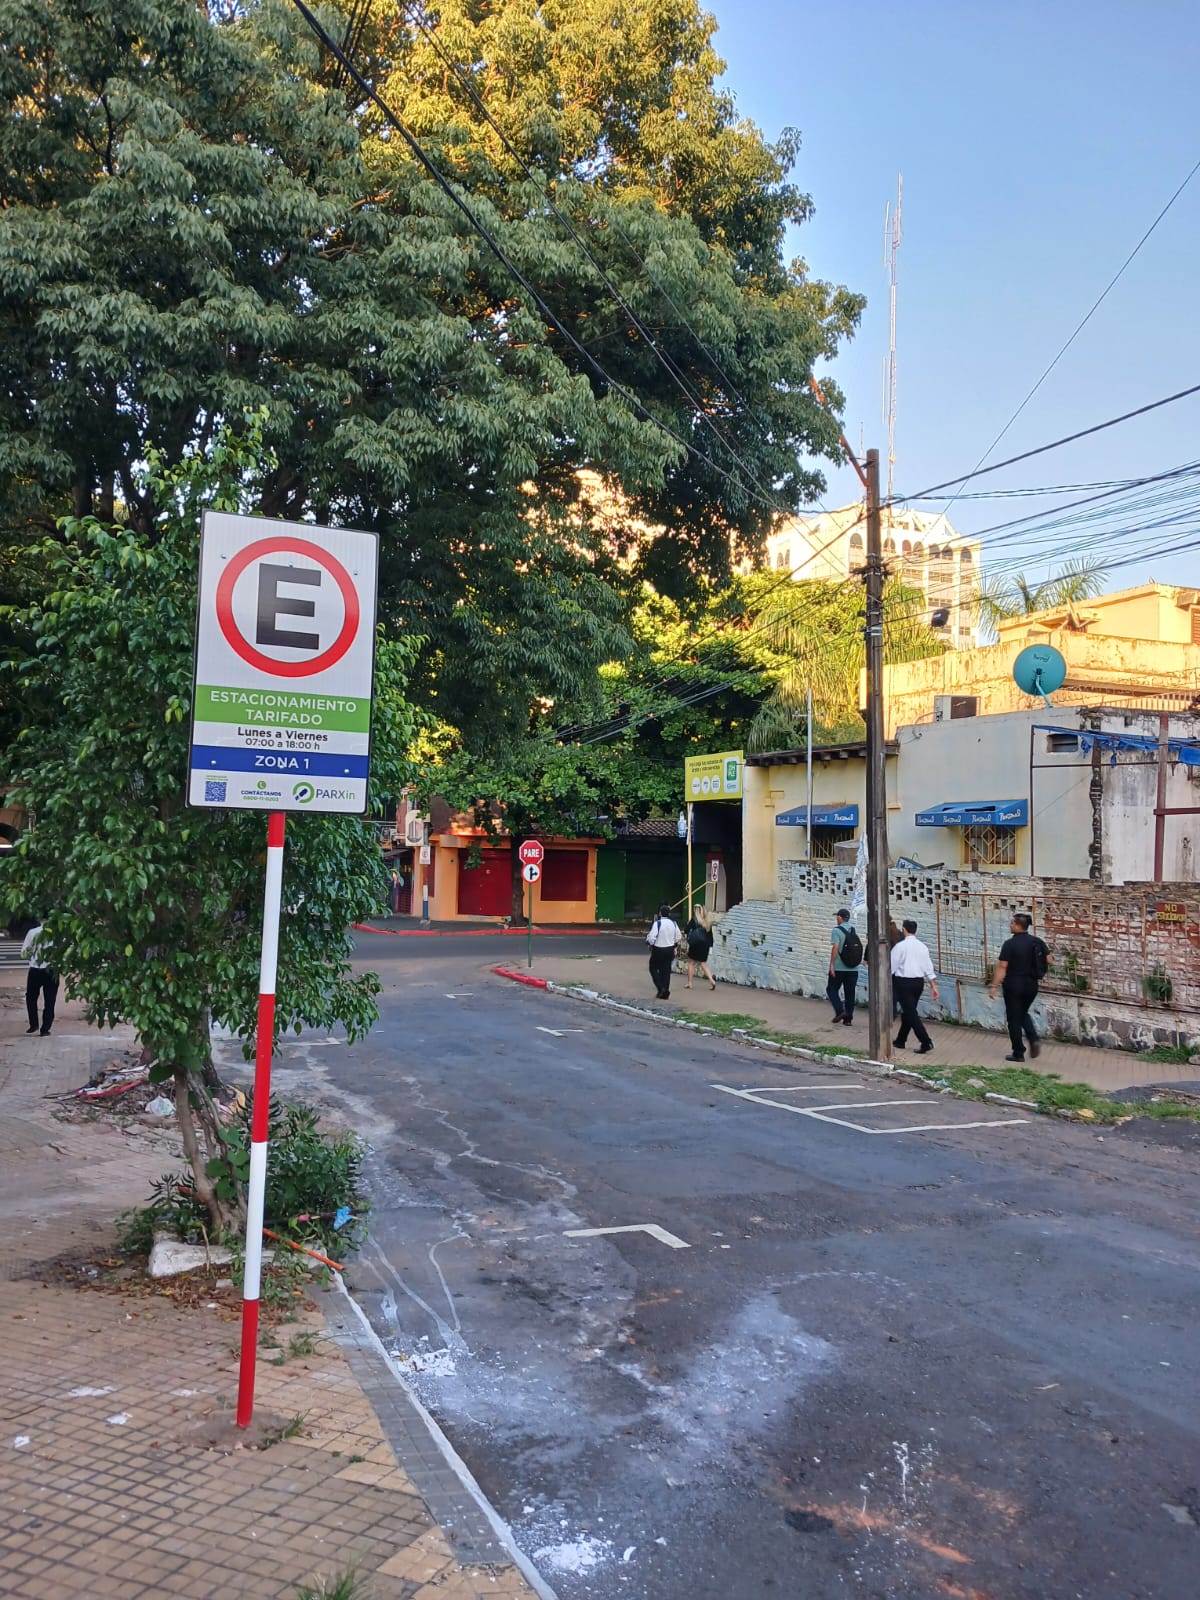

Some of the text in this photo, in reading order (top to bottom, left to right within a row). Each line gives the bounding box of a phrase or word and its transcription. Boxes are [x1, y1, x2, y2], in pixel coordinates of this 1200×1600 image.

[256, 562, 322, 650] E
[210, 690, 357, 713] ESTACIONAMIENTO
[245, 709, 323, 726] TARIFADO
[238, 726, 328, 742] Lunes a Viernes
[245, 738, 275, 748] 07:00
[285, 740, 312, 750] 18:00
[314, 742, 320, 750] h
[254, 755, 310, 769] ZONA 1
[316, 788, 356, 800] PARXin
[523, 848, 540, 858] PARE
[1164, 904, 1178, 912] NO
